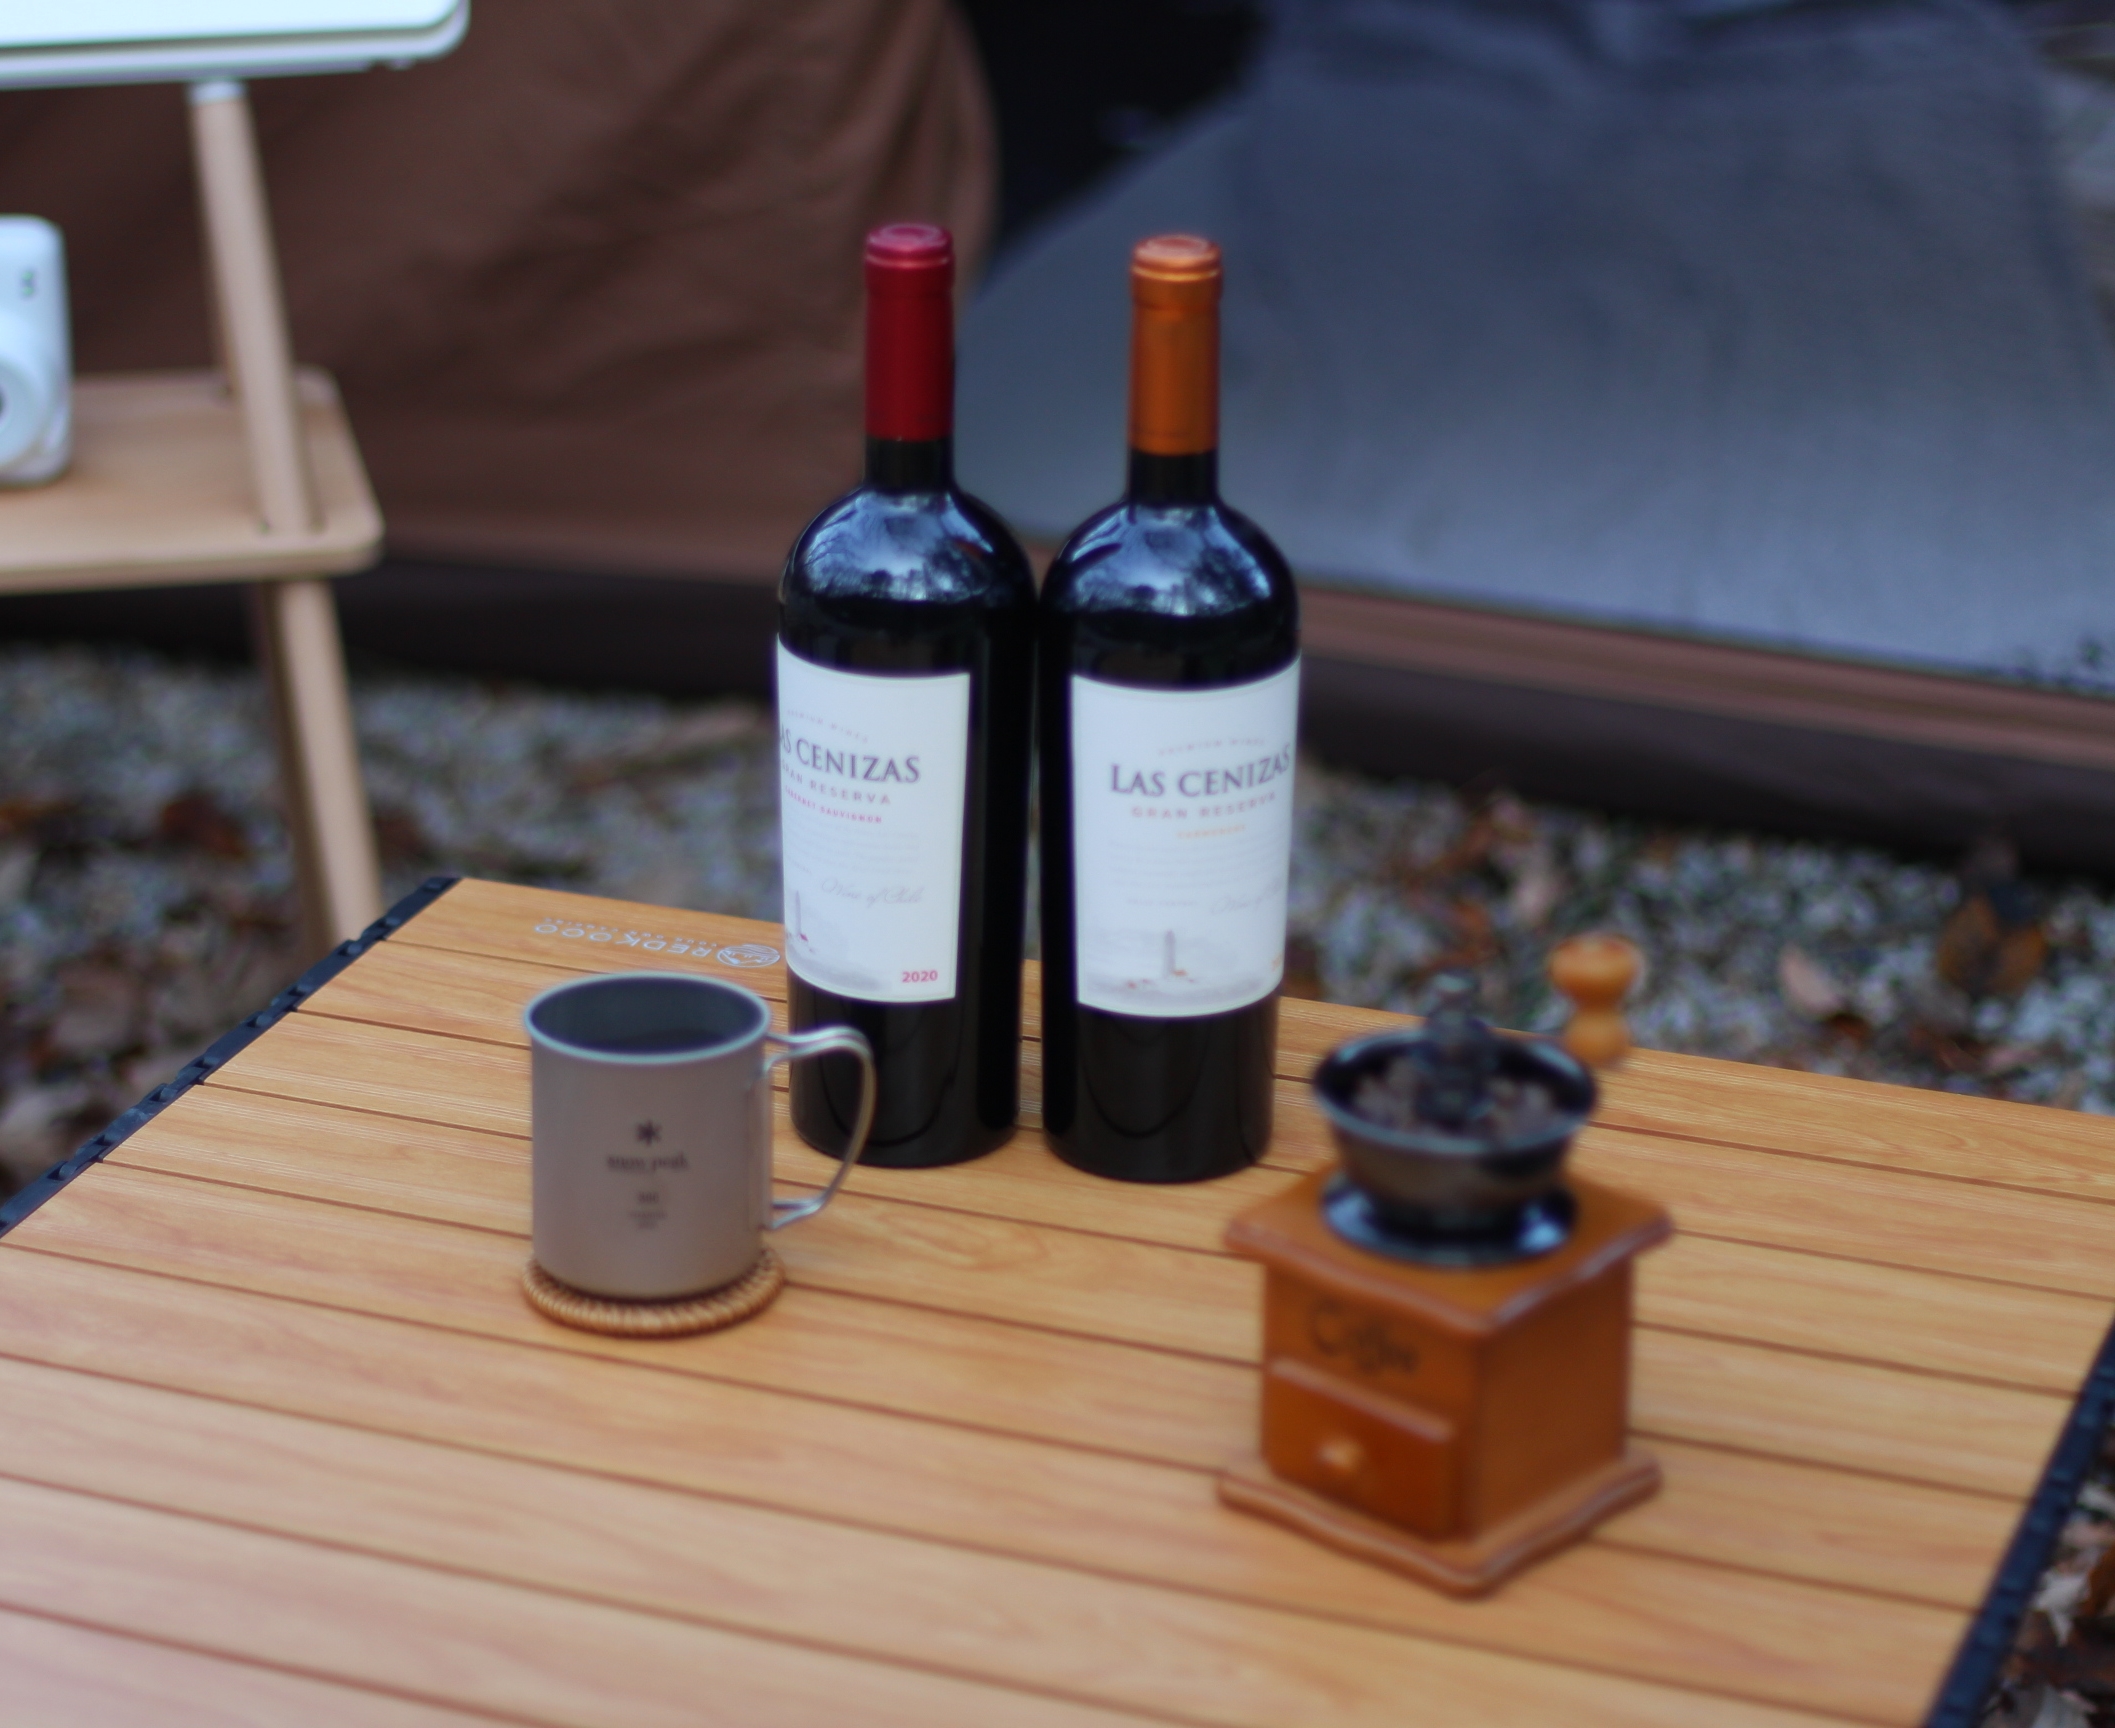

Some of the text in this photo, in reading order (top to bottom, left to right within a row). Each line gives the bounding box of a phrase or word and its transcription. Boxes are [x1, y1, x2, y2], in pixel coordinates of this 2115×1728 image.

[780, 721, 921, 783] AS CENIZAS
[1110, 742, 1291, 798] LAS CENIZAS
[810, 779, 891, 806] RESERVA
[1131, 791, 1276, 819] GRAN RESERVA
[819, 805, 883, 824] SAUVIGNON
[901, 969, 939, 984] 2020
